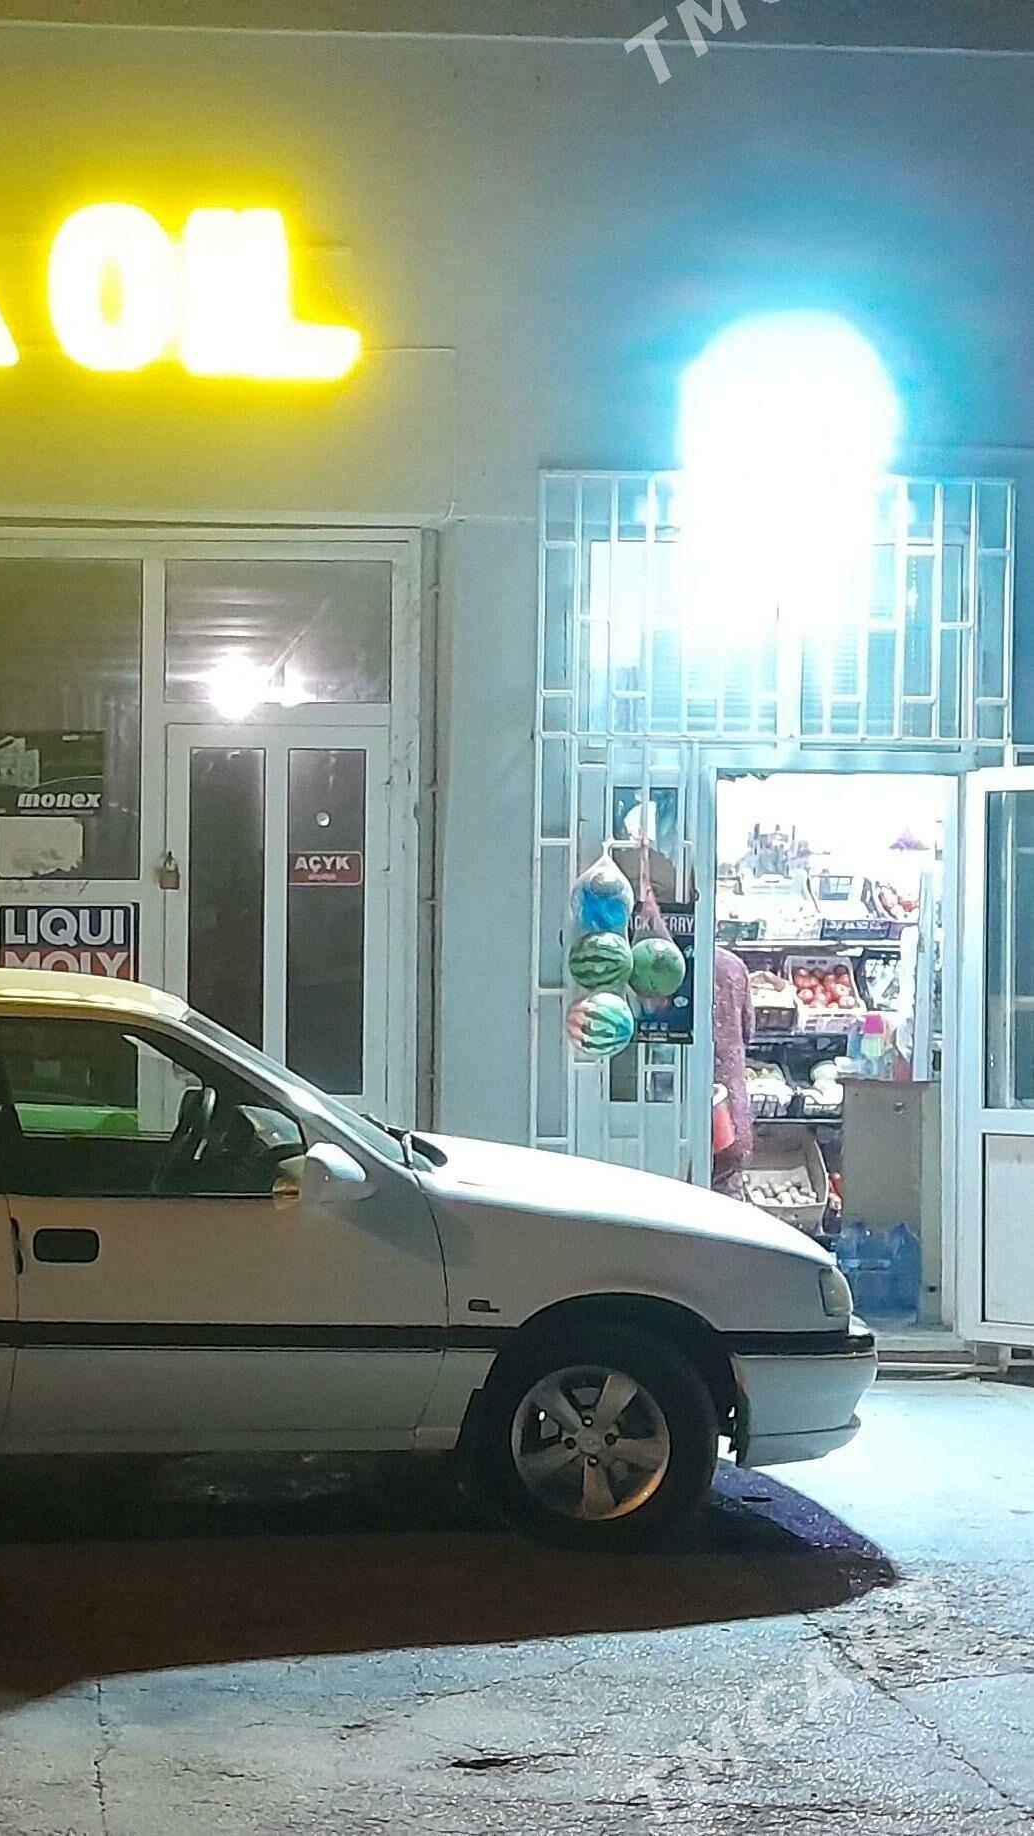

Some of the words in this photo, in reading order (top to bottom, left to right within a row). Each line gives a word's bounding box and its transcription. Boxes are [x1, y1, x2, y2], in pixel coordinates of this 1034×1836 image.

[47, 202, 362, 381] OIL
[17, 793, 101, 808] monex
[294, 855, 350, 873] AÇYK
[5, 908, 125, 947] LIQUI
